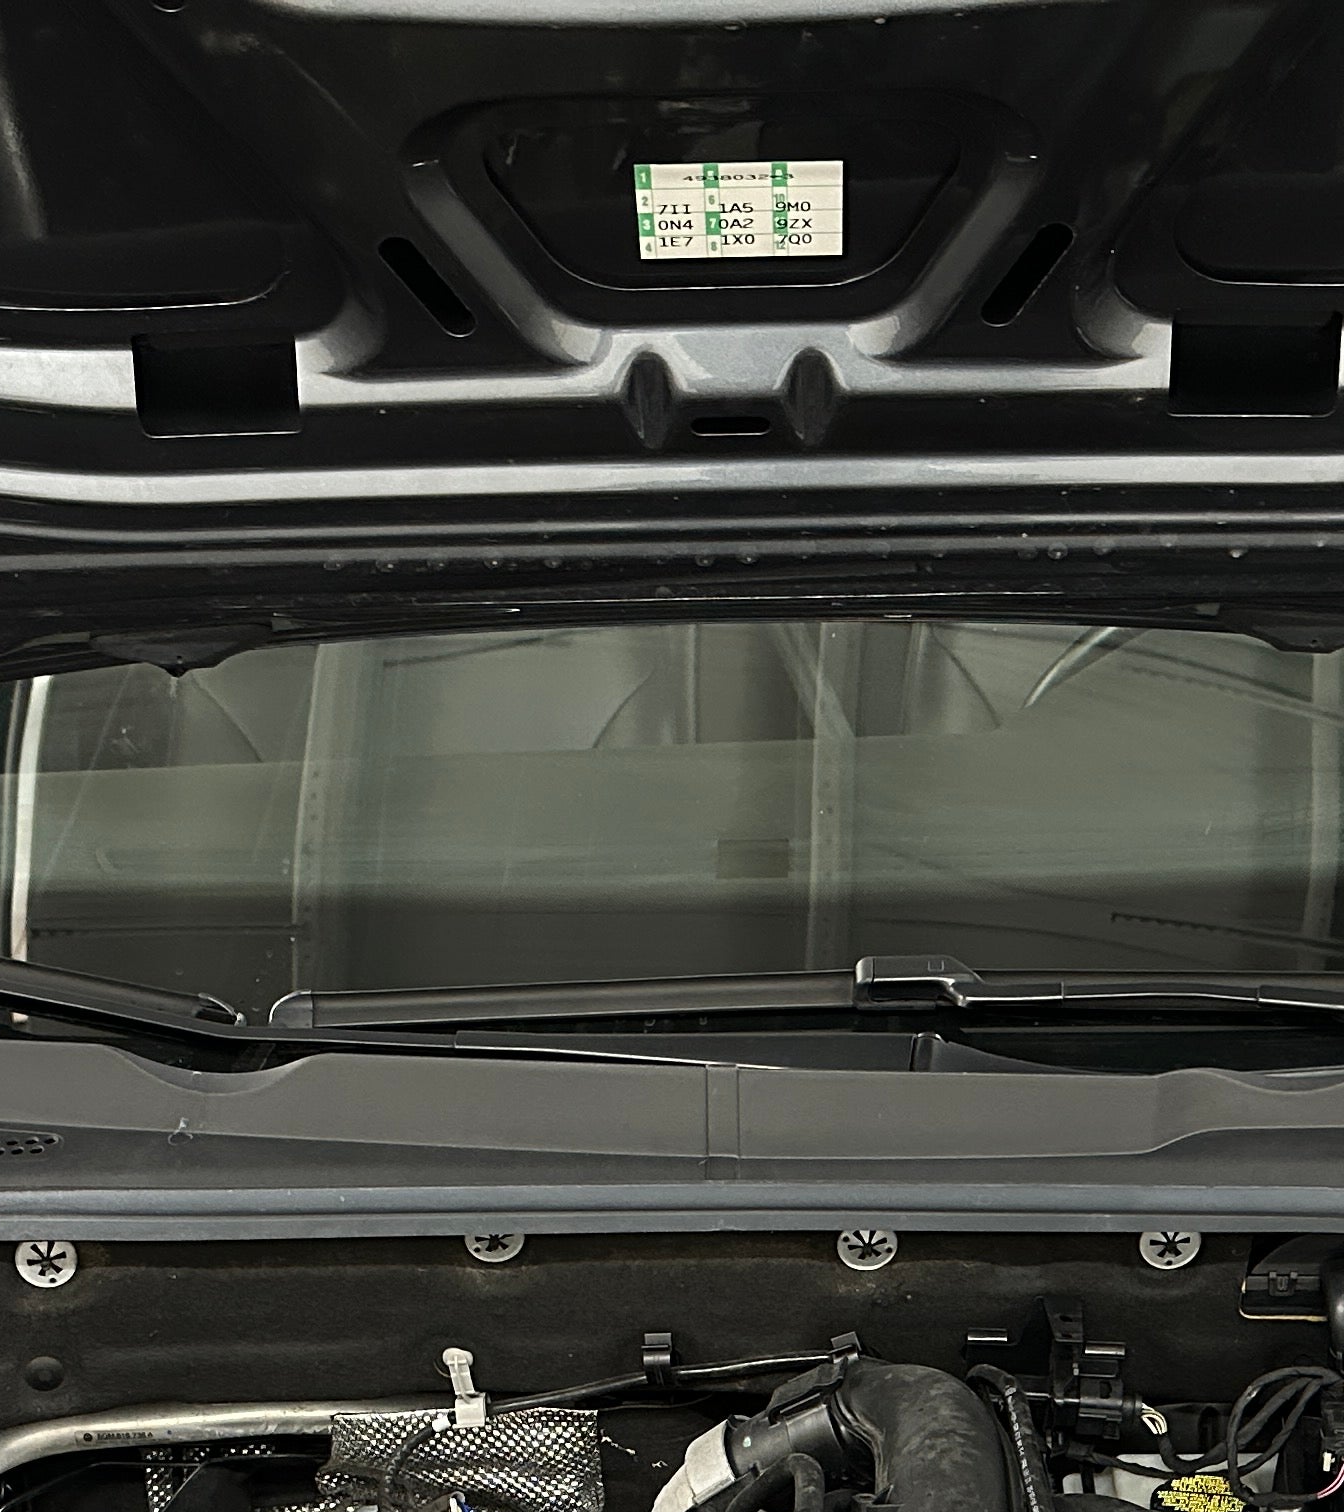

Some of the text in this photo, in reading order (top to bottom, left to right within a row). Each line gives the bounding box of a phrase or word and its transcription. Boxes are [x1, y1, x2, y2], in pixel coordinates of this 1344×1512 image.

[640, 173, 646, 182] 1
[641, 196, 648, 206] 2
[708, 195, 715, 205] 6
[720, 202, 754, 213] 1A5
[642, 219, 651, 230] 3
[710, 218, 716, 228] 7
[718, 218, 754, 229] 0A2
[776, 218, 812, 229] 9ZX
[659, 233, 812, 248] 1E7 1X0 7Q0
